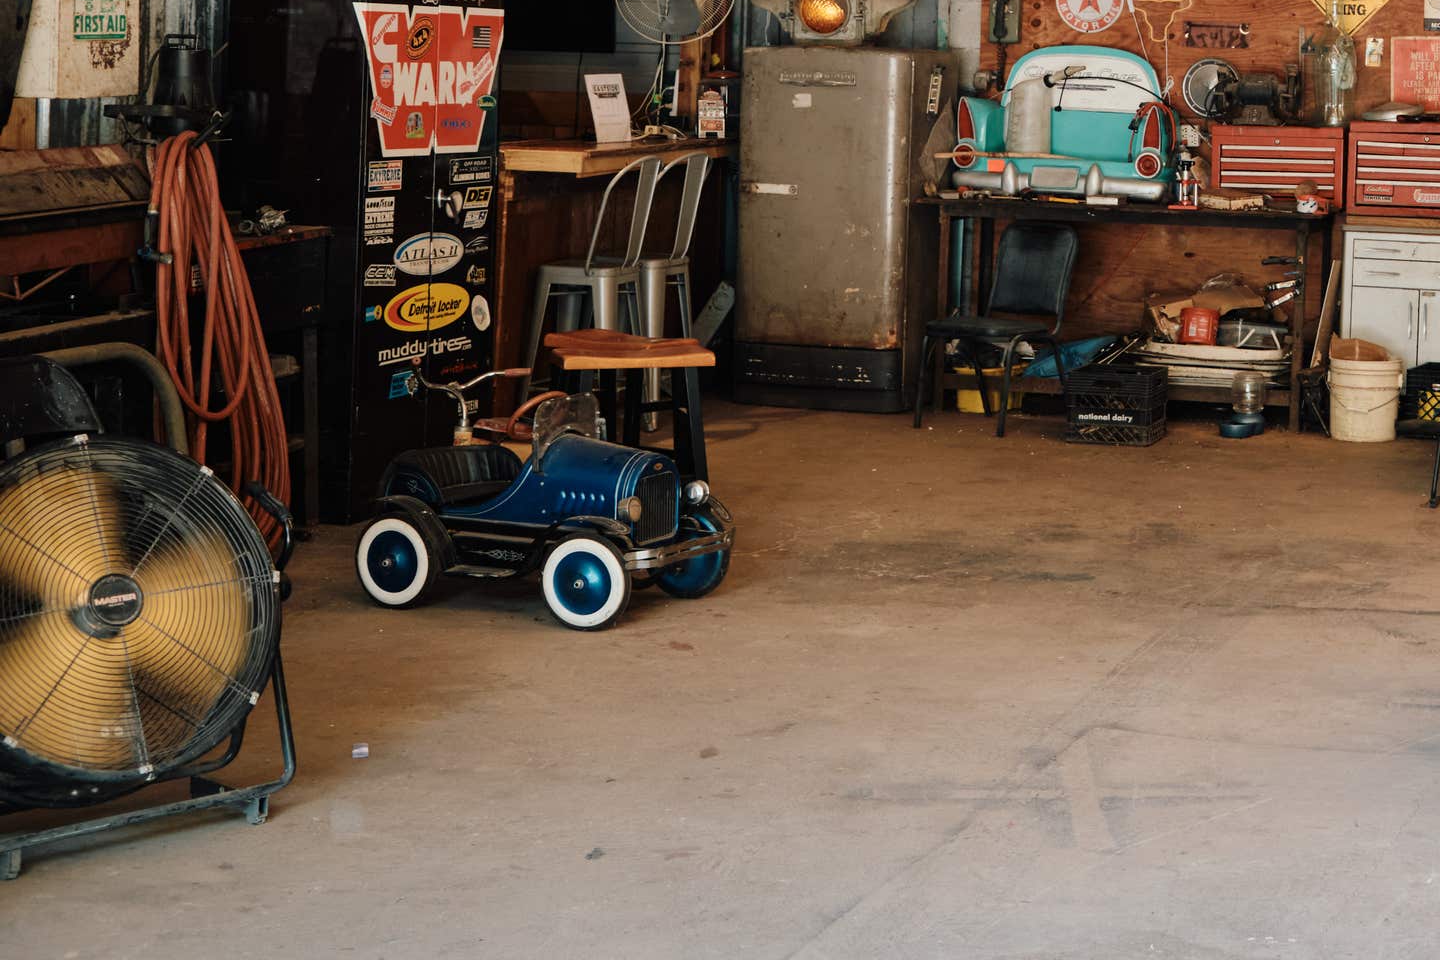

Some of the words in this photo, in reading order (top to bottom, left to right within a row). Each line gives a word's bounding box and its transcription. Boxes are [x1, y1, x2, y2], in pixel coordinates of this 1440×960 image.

[1060, 3, 1100, 30] MOTOR
[1103, 5, 1120, 23] OIL
[1338, 4, 1367, 16] ING
[73, 15, 104, 33] FIRST
[107, 14, 127, 32] AID
[1410, 52, 1432, 62] WILL
[1409, 61, 1435, 71] AFTER
[1415, 71, 1424, 80] IS
[393, 61, 475, 107] WARN
[400, 247, 446, 261] ATLAS
[408, 301, 437, 317] Detroit
[437, 299, 462, 312] Locker
[1078, 413, 1111, 421] national
[1112, 414, 1133, 423] dairy
[94, 592, 137, 606] MASTER
